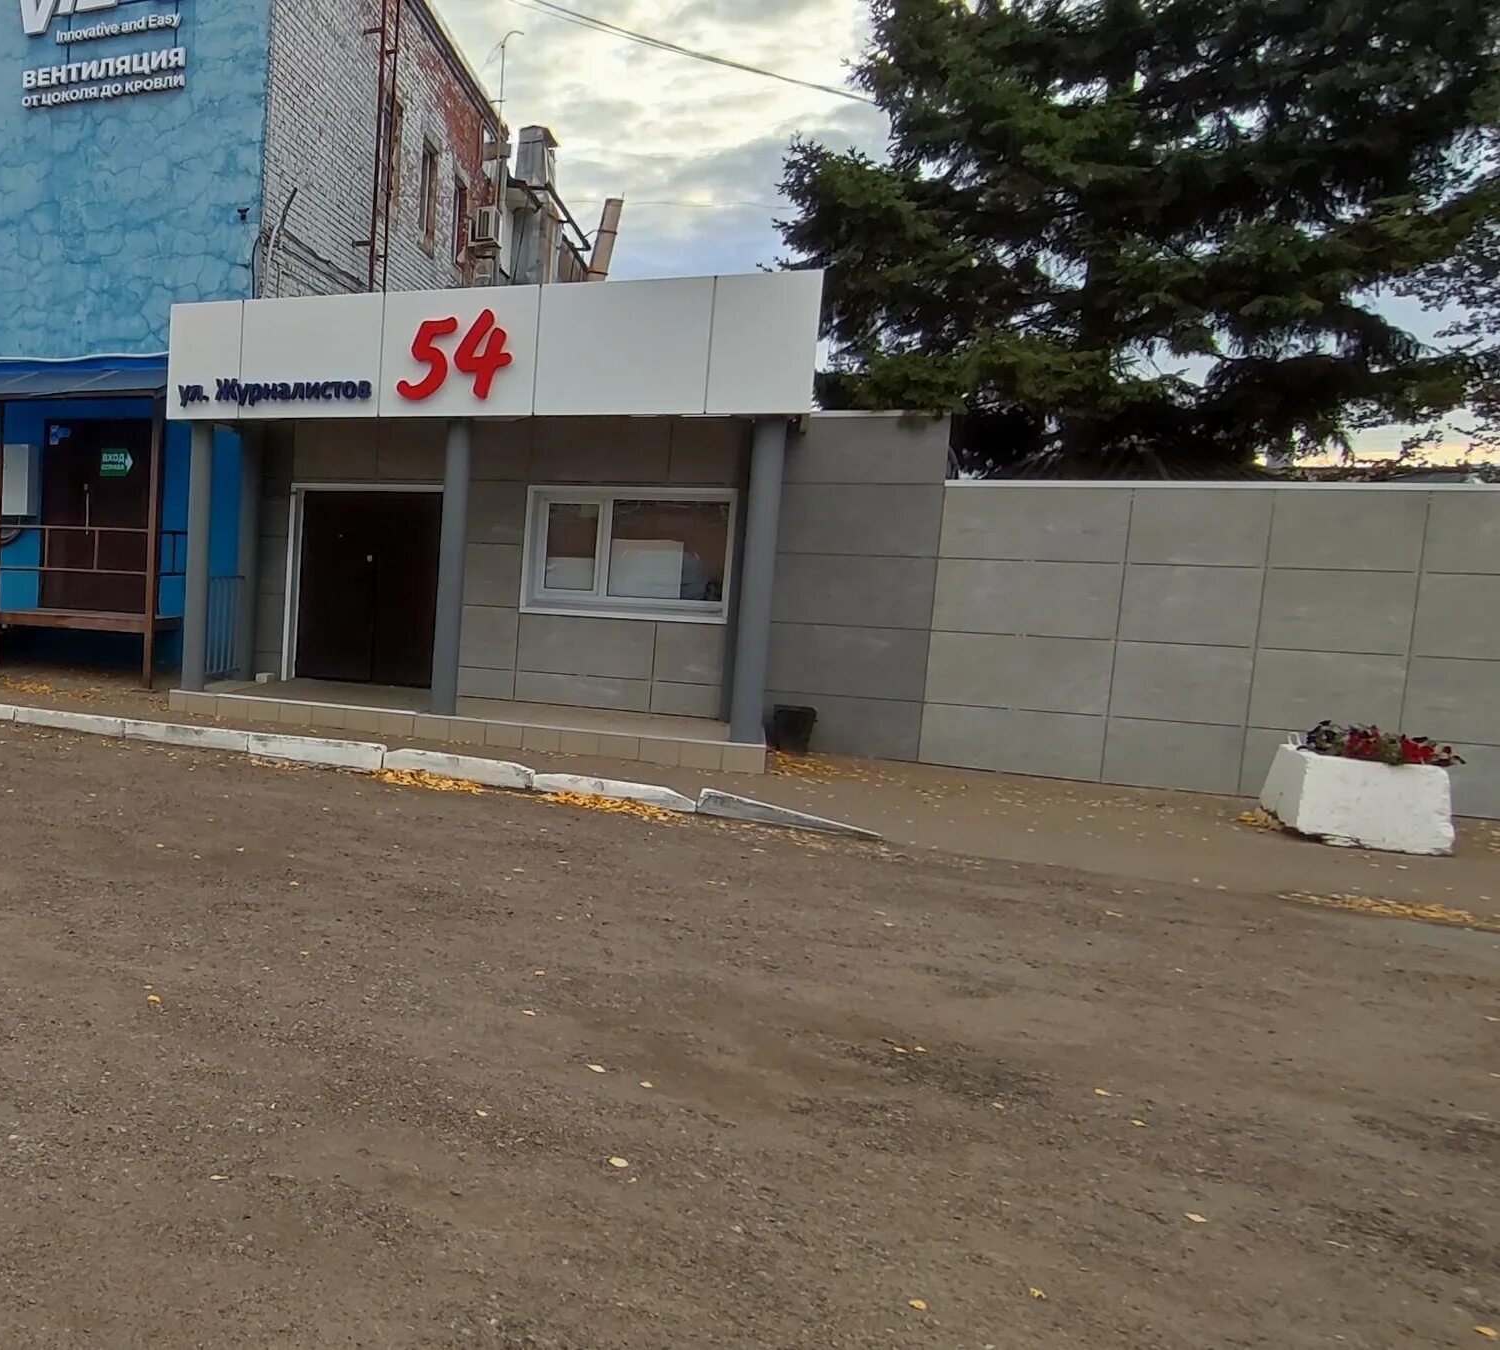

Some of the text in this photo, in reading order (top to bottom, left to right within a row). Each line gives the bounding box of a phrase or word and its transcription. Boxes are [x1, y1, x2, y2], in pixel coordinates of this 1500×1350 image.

[56, 23, 118, 44] Innovative
[120, 16, 147, 32] and
[148, 12, 182, 27] Easy
[22, 47, 187, 89] ВЕНТИЛЯЦИЯ
[21, 73, 186, 108] ОТ ЦОКОЛЯ ДО КРОВЛИ
[395, 308, 513, 401] 54
[178, 377, 373, 408] ул. Журналистов
[102, 453, 125, 463] ВХОД
